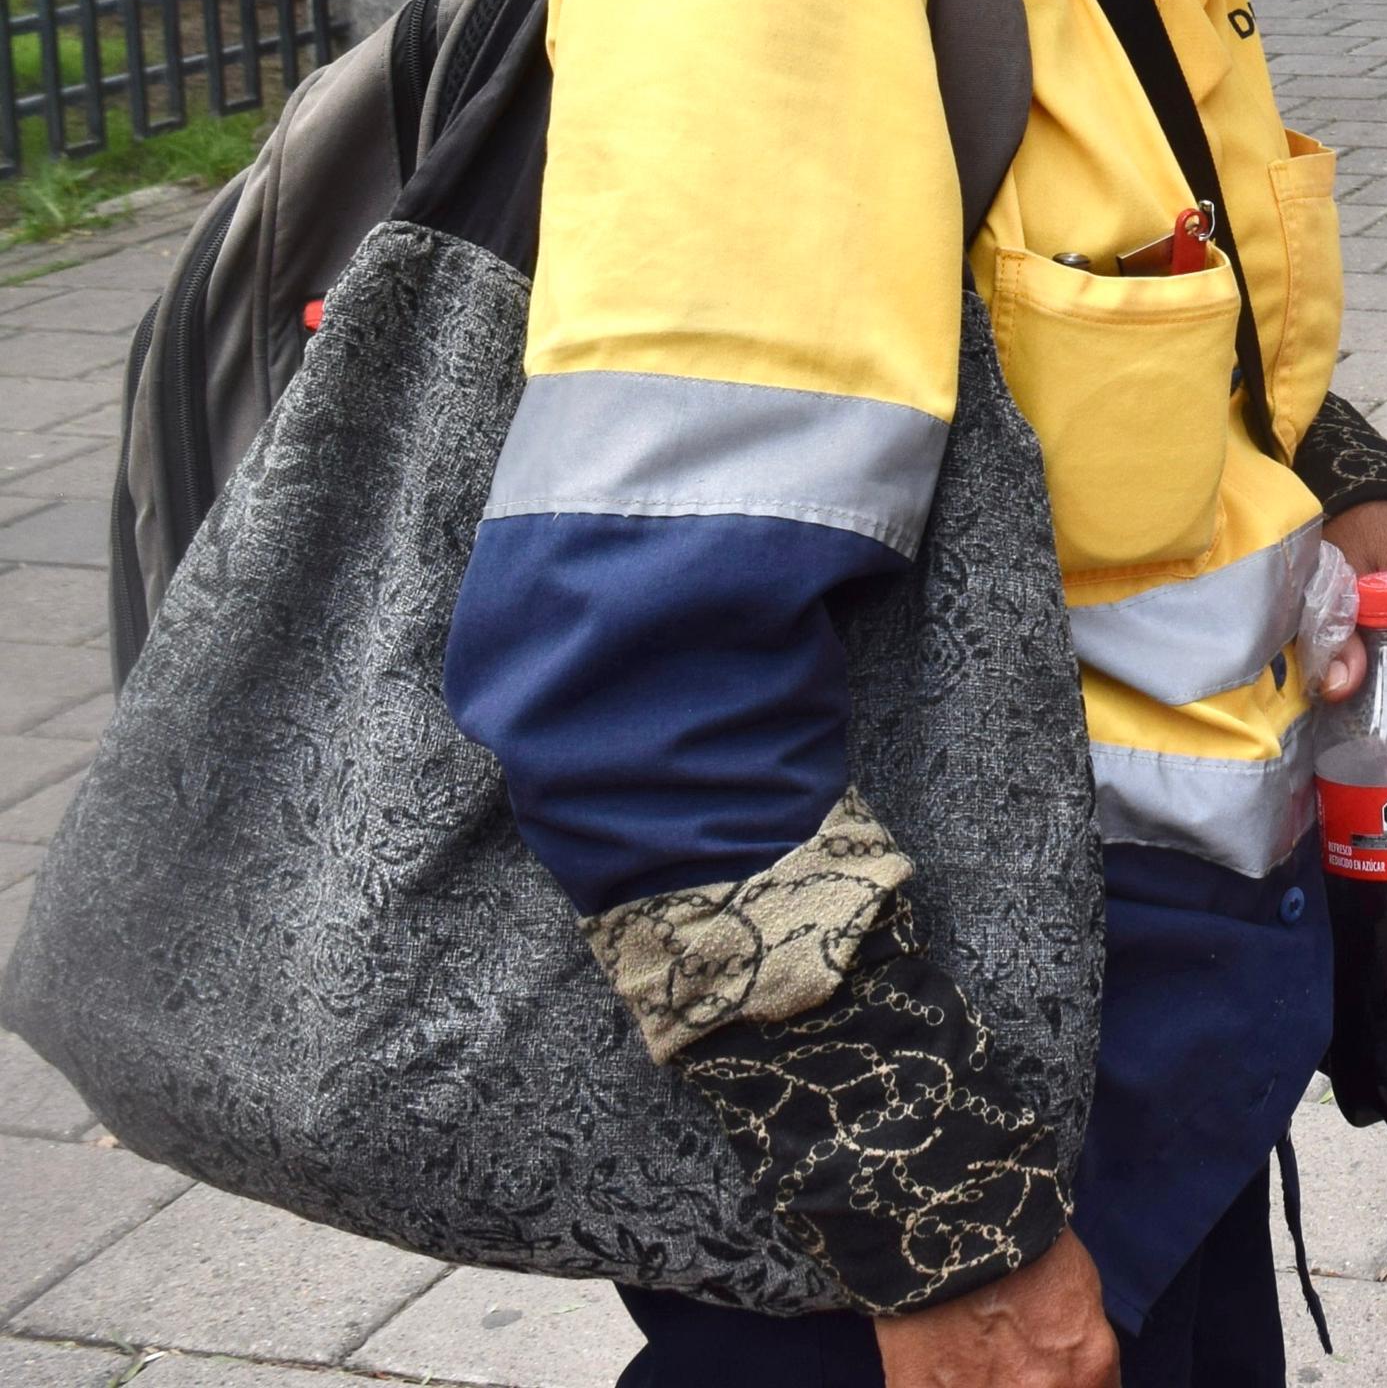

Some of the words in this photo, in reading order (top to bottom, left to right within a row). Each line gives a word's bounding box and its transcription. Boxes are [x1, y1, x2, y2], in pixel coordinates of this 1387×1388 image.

[1328, 841, 1353, 856] REFRESCO
[1329, 854, 1353, 869] REDUCIDO
[1353, 859, 1363, 870] EN
[1361, 857, 1386, 872] AZÚCAR
